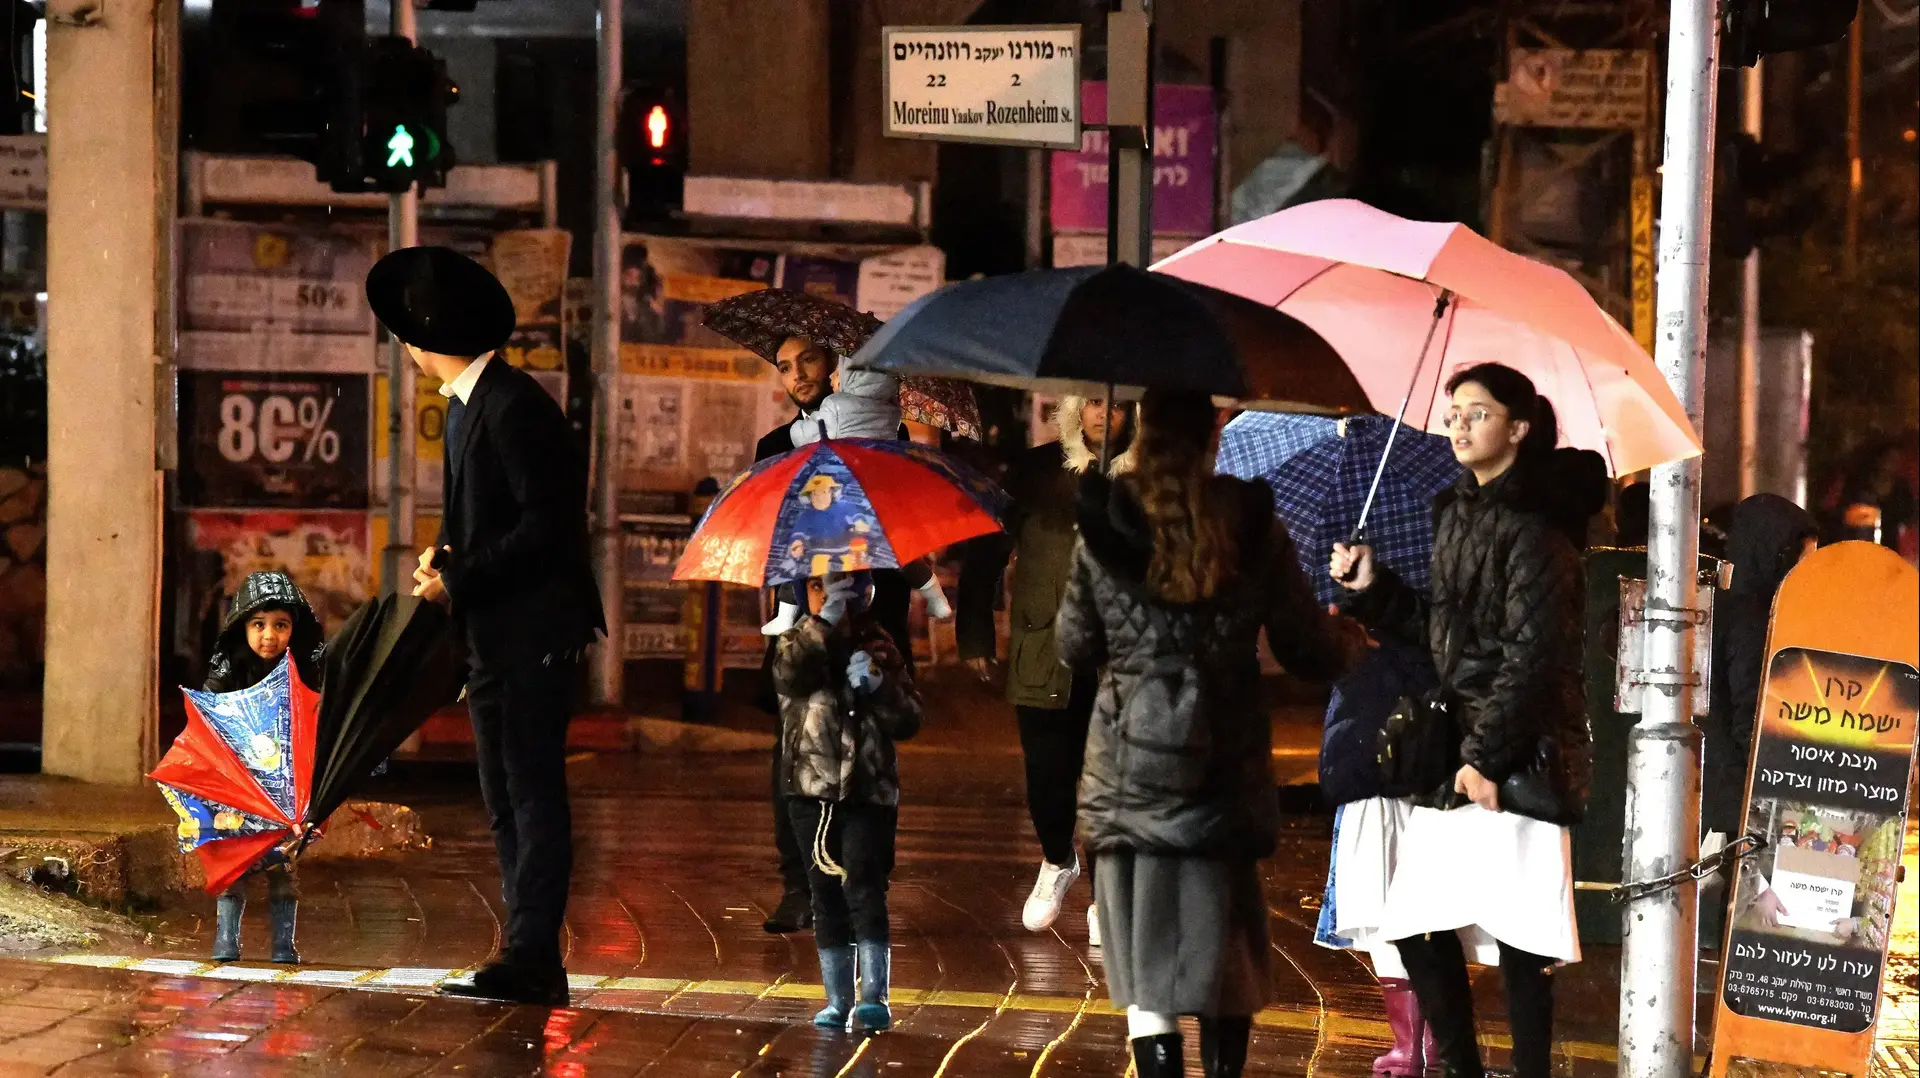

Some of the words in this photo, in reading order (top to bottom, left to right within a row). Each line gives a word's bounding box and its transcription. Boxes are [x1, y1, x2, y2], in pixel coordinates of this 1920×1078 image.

[893, 40, 970, 60] רוזנהיים
[975, 48, 1004, 63] יעקב
[1008, 40, 1054, 60] מורנו
[1057, 46, 1073, 58] רח'
[926, 74, 947, 87] 22
[1011, 73, 1021, 87] 2
[893, 100, 949, 124] Moreinu
[952, 108, 984, 124] Yaakov
[986, 100, 1058, 124] Rozenheim
[1060, 107, 1073, 123] St.
[1825, 677, 1863, 700] קרן
[1778, 701, 1831, 725] משה
[1840, 709, 1901, 733] ישמח
[1791, 744, 1835, 764] איסוף
[1838, 751, 1877, 770] תיבת
[1761, 768, 1811, 788] וצדקה
[1817, 777, 1848, 794] מזון
[1854, 782, 1899, 801] מוצרי
[1790, 881, 1807, 890] משה
[1809, 884, 1829, 894] ישמח
[1830, 886, 1843, 897] קרן
[1735, 942, 1766, 960] להם
[1773, 949, 1812, 967] לעזור
[1817, 954, 1837, 971] לנו
[1843, 960, 1874, 978] עזרו
[1729, 970, 1743, 981] ברק
[1745, 973, 1755, 982] בני
[1771, 976, 1787, 988] יעקב
[1727, 983, 1775, 998] 03-6765715
[1835, 986, 1851, 997] ראשי
[1854, 989, 1873, 1001] משרד
[1806, 996, 1855, 1011] 03-6783030
[1758, 1004, 1837, 1024] www.kym.org.il
